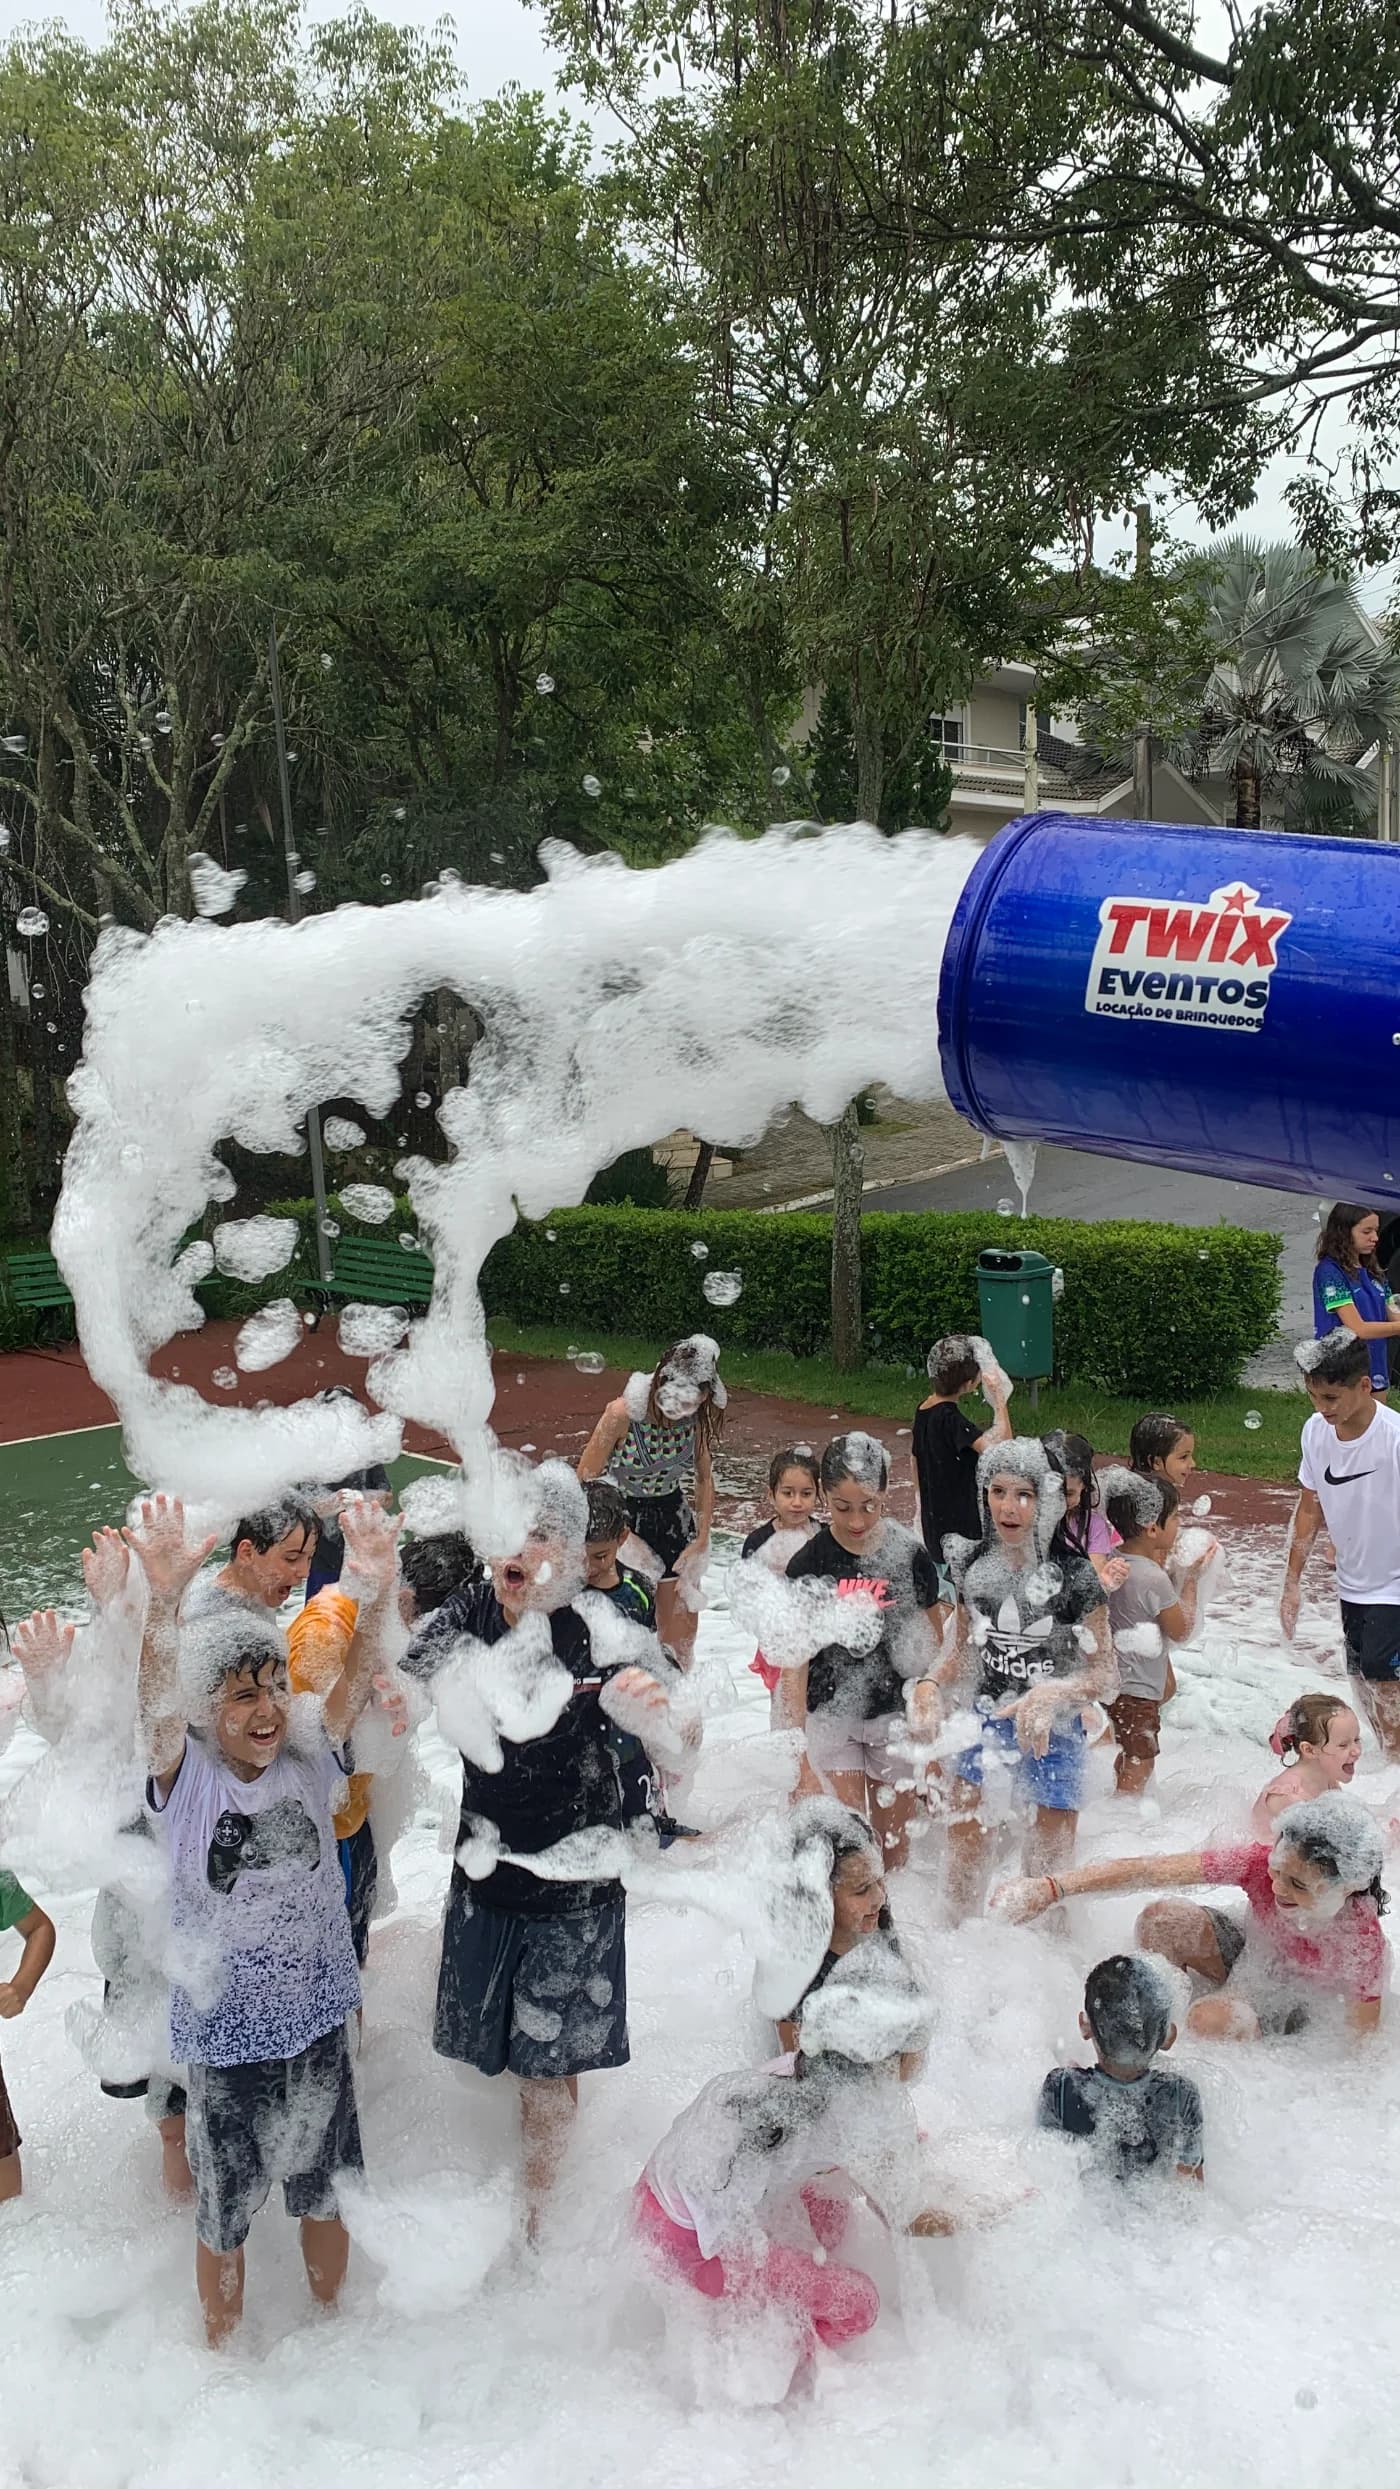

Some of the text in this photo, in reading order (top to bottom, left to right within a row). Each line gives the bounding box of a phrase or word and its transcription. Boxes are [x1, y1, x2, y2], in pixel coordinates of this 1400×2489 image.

[1096, 1002, 1265, 1029] LOCAÇÃO DE BRINQUEDOS
